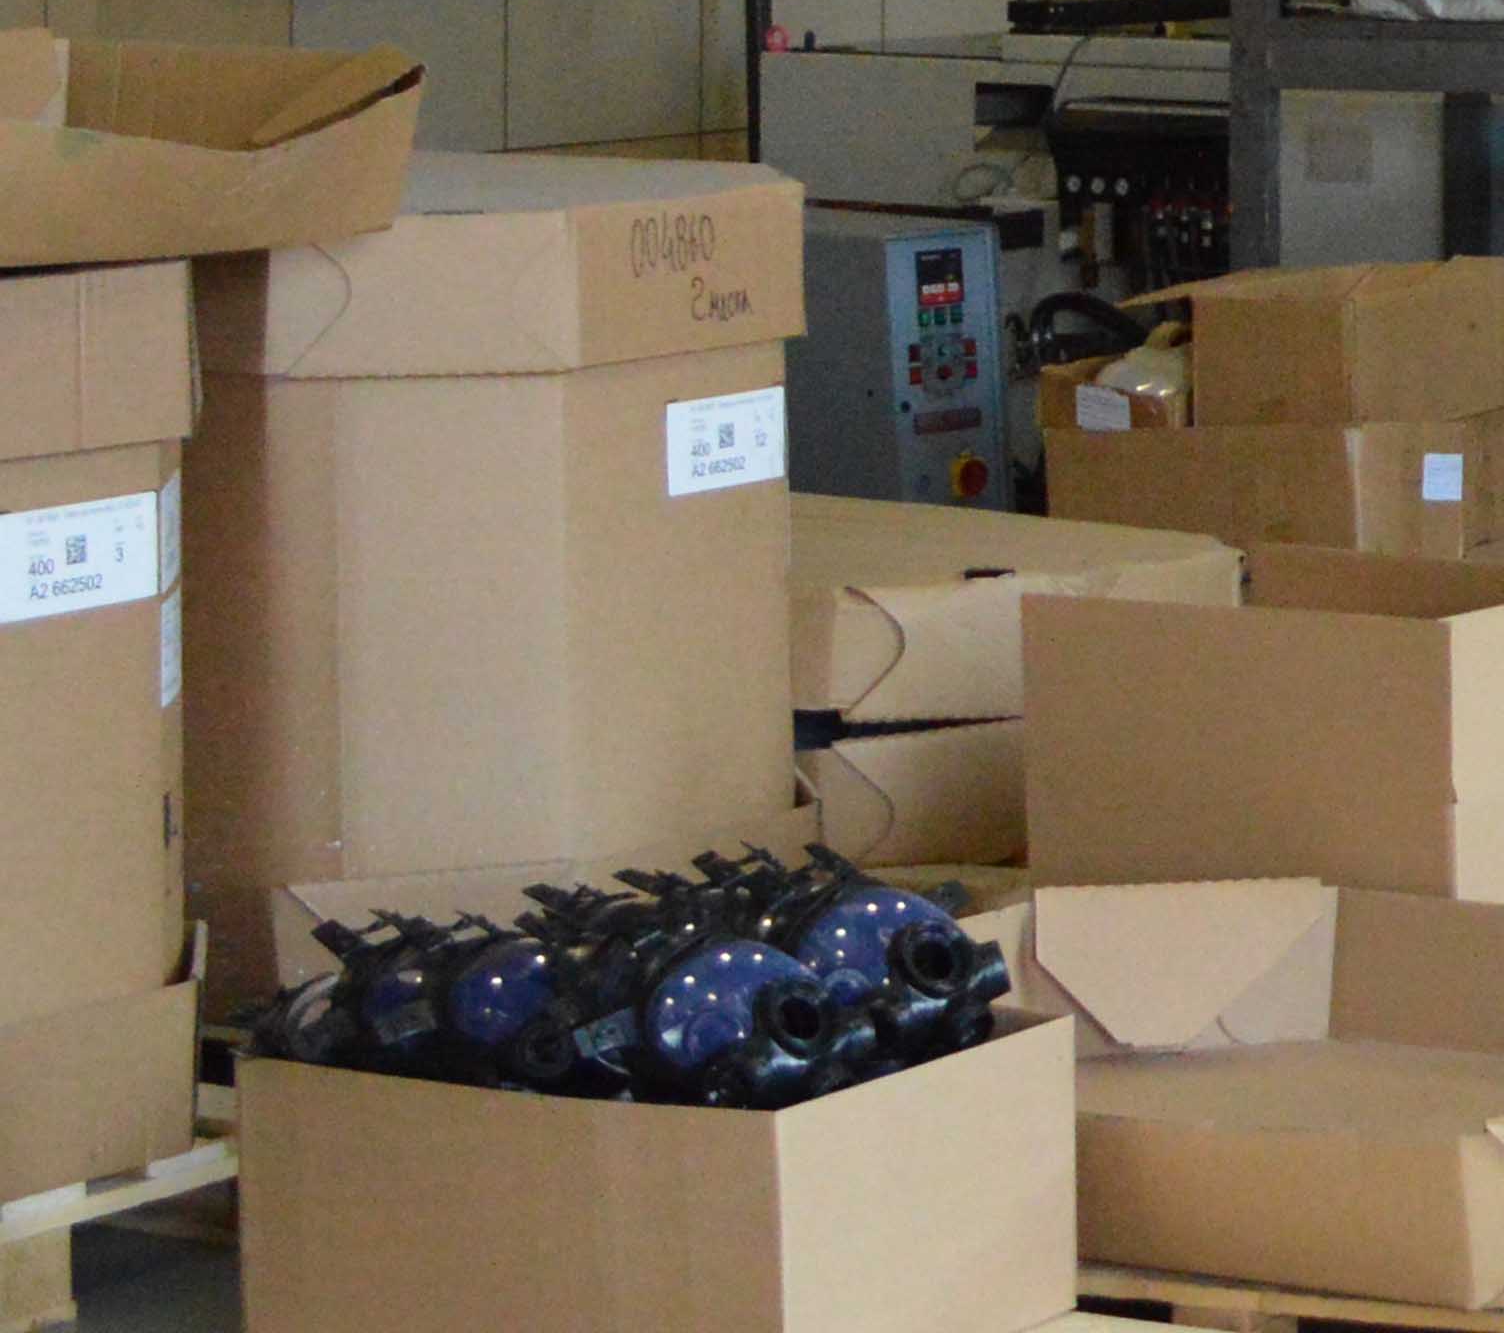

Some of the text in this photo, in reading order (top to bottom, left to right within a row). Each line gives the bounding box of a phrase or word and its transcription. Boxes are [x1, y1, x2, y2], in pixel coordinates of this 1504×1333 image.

[28, 558, 55, 576] 400
[29, 573, 103, 600] A2 662502
